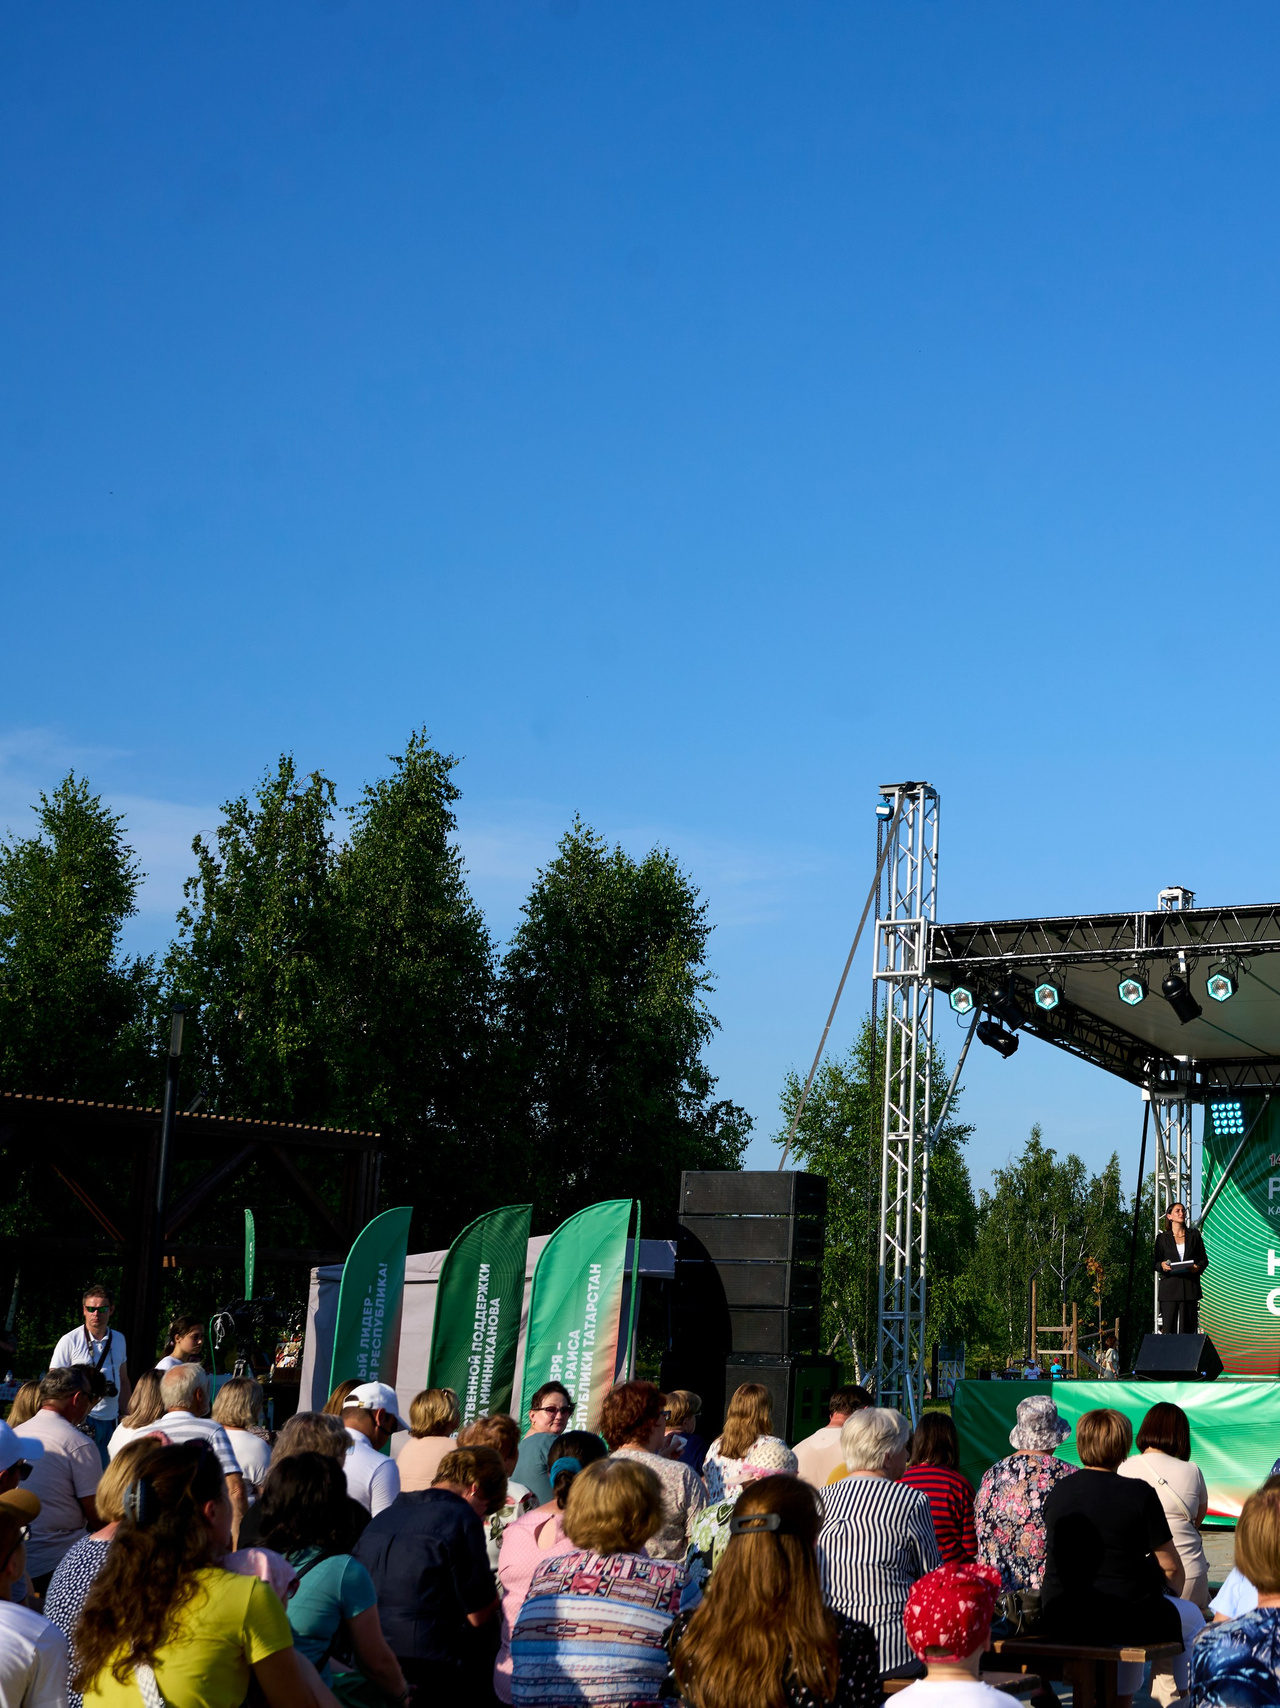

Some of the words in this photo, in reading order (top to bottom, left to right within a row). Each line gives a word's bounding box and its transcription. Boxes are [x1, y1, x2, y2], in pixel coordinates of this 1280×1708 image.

[360, 1297, 375, 1350] ЛИДЕР
[370, 1262, 388, 1368] РЕСПУБЛИКА!
[471, 1263, 491, 1352] ПОДДЕРЖКИ
[582, 1263, 602, 1348] ТАТАРСТАН
[479, 1297, 501, 1405] МИННИХАНОВА
[564, 1329, 581, 1380] РАИСА
